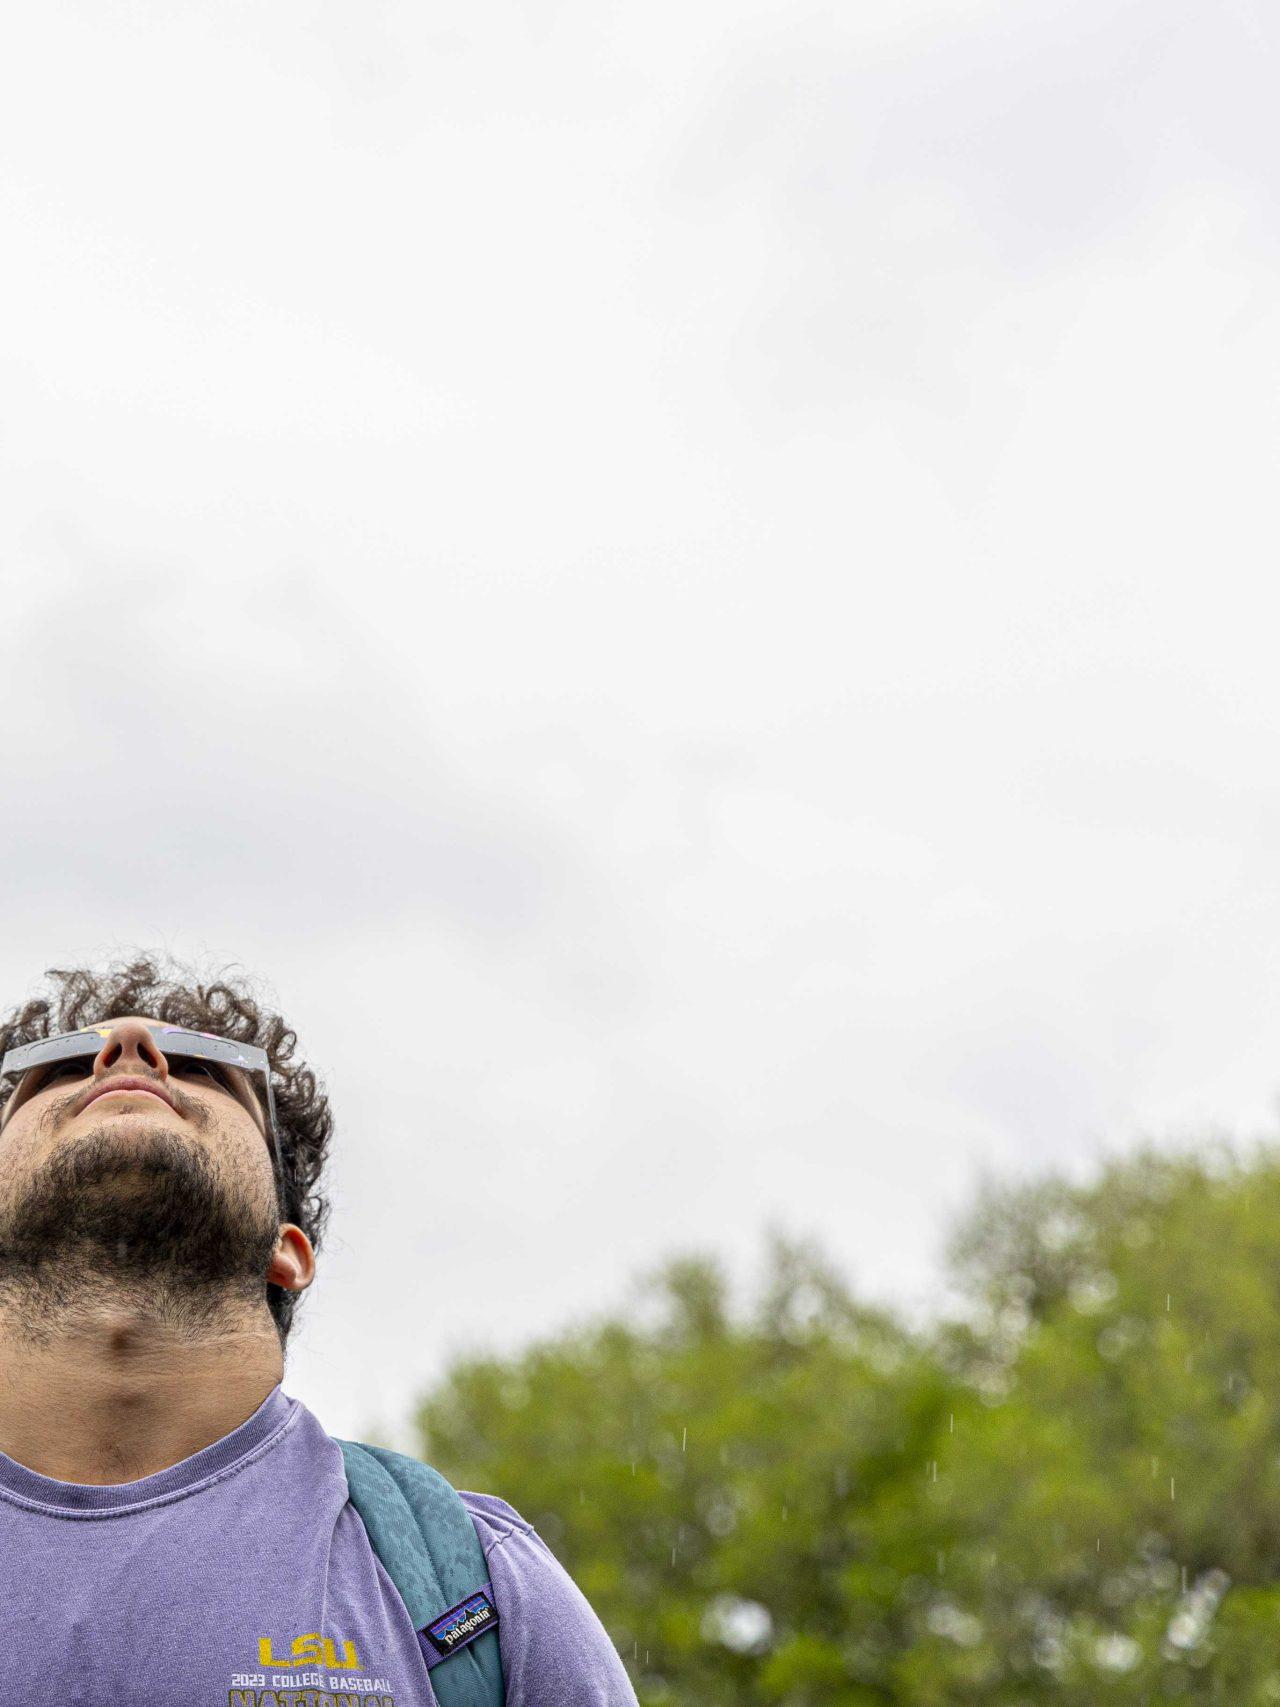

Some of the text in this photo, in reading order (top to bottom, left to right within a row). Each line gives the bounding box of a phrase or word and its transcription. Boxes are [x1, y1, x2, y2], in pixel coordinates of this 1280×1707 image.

[444, 1609, 491, 1645] patagonia
[258, 1632, 360, 1670] LSU
[231, 1673, 394, 1693] 2023 COLLEGE BASEBALL
